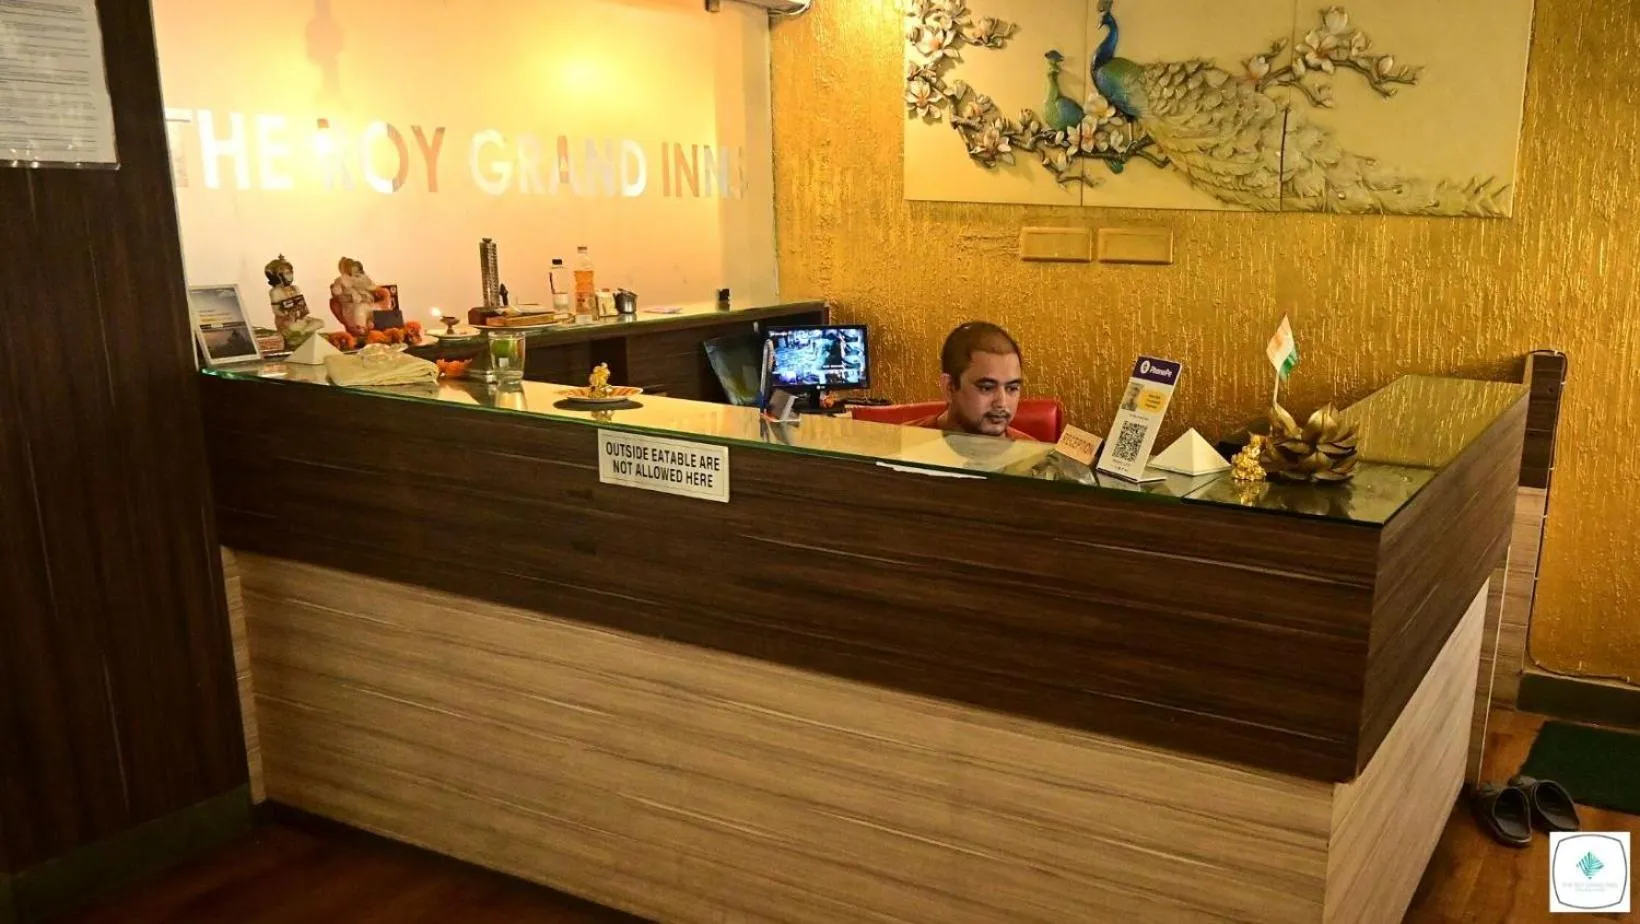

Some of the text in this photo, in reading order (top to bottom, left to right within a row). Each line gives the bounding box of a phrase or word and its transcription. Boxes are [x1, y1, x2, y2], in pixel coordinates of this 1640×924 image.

[164, 107, 294, 191] THE
[314, 117, 446, 195] ROY
[469, 128, 648, 198] GRAND
[605, 441, 720, 471] OUTSIDE EATABLE ARE
[613, 460, 713, 488] NOT ALLOWED HERE
